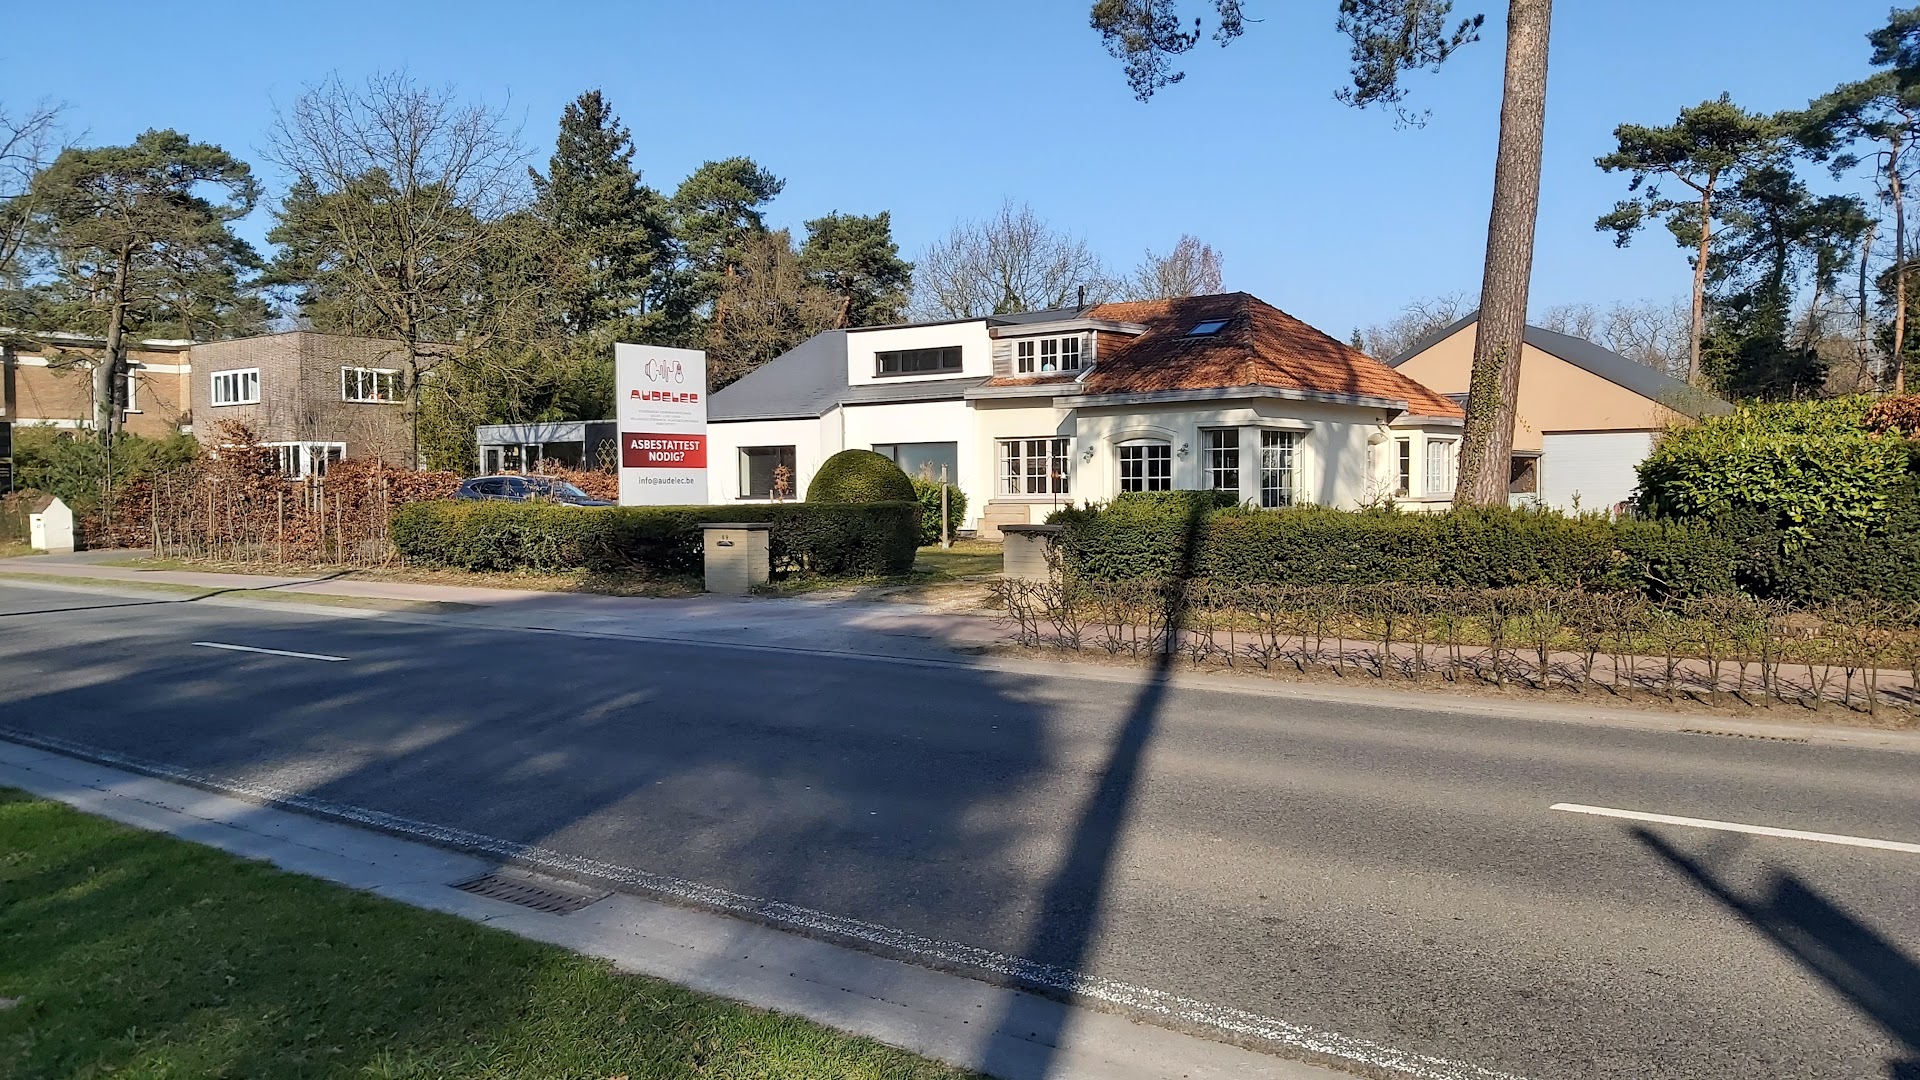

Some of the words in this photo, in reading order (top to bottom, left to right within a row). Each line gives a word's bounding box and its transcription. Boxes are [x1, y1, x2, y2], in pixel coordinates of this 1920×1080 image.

[631, 439, 700, 451] ASBESTATTEST
[649, 451, 685, 462] NODIG?
[638, 476, 694, 485] info@audelec.be
